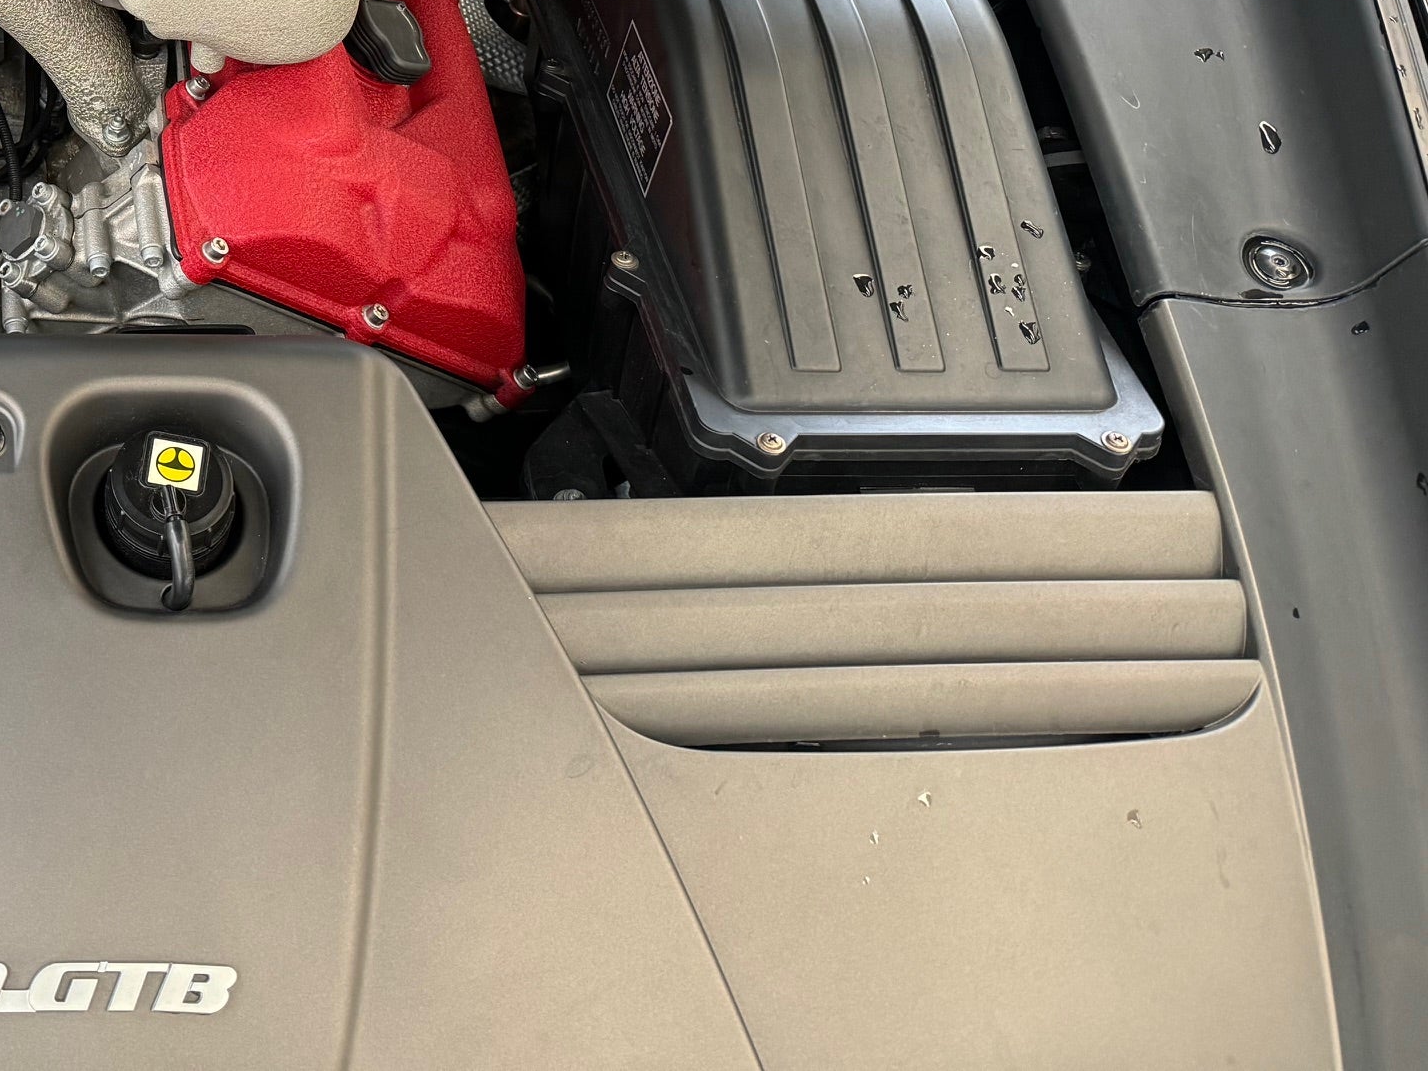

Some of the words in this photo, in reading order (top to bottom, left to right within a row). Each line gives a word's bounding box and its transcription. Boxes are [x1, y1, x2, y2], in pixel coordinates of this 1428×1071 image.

[630, 51, 641, 79] ALTA
[639, 73, 659, 126] TENSIONE
[637, 47, 661, 109] ATTENZIONE
[626, 87, 645, 135] WARNING
[628, 112, 646, 159] VOLTAGE
[29, 961, 238, 1015] GTB
